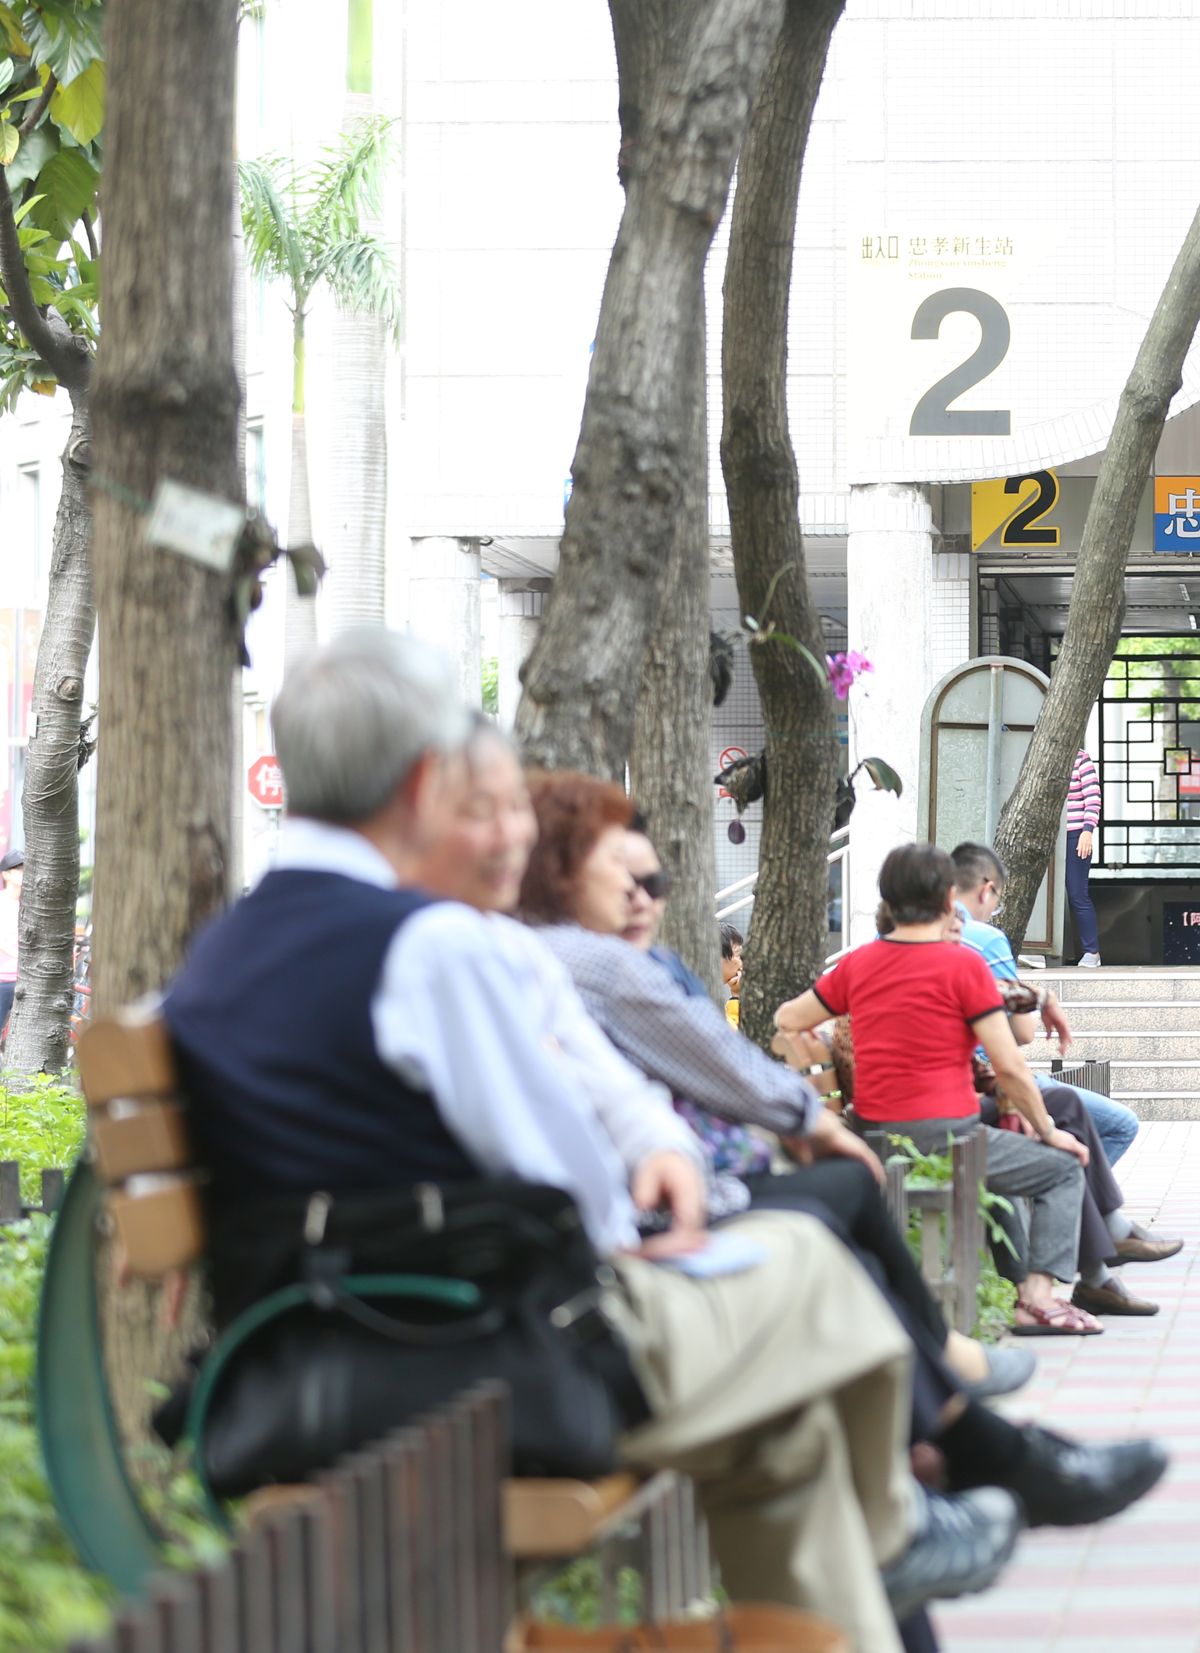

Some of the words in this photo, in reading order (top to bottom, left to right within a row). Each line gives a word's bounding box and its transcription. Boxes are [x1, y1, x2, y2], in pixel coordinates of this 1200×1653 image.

[862, 236, 899, 259] 出入口
[908, 236, 1014, 256] 忠孝新生站
[909, 287, 1011, 436] 2
[1003, 472, 1058, 545] 2
